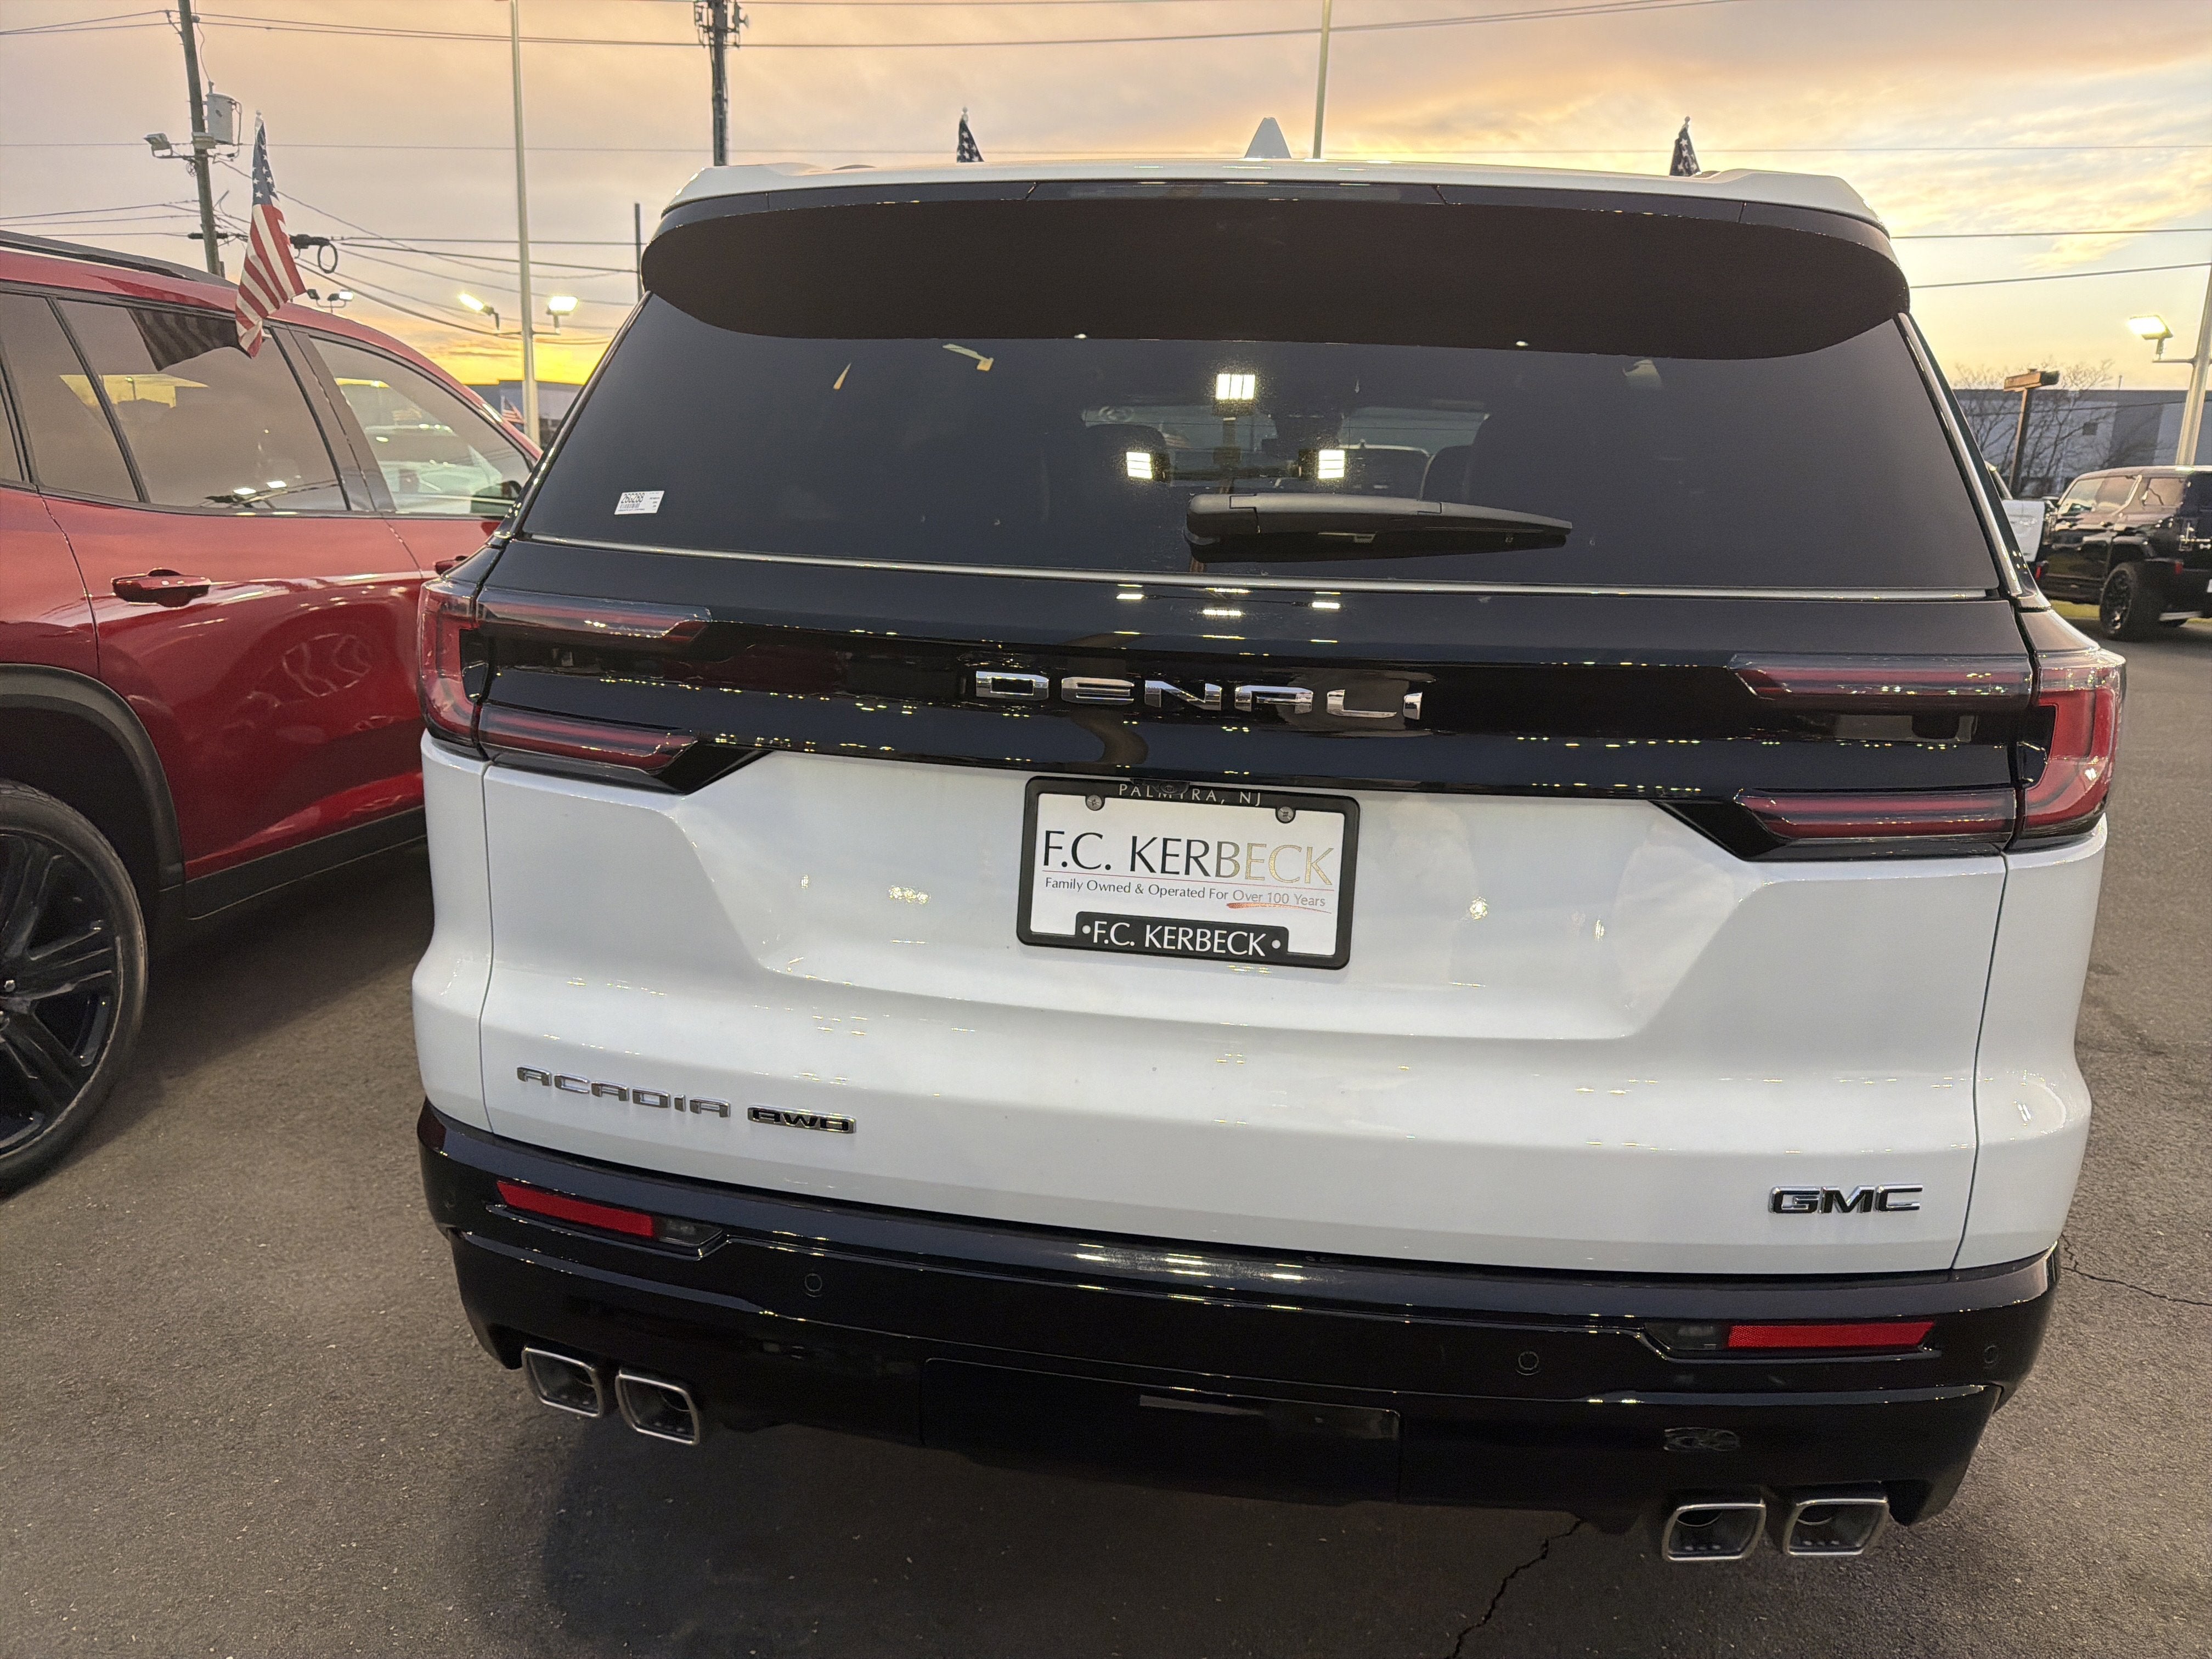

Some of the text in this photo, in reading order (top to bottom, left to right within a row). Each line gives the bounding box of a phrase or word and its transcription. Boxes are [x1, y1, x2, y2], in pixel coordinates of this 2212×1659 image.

[975, 670, 1423, 720] DENALI
[1239, 791, 1261, 806] NJ
[1043, 830, 1334, 885] F.C. KERBECK
[1045, 878, 1325, 907] Family Owned & Operated For Over 100 Years
[1093, 921, 1266, 957] F.C. KERBECK
[517, 1065, 854, 1132] ACADIA AWD
[1769, 1183, 1923, 1214] GMC
